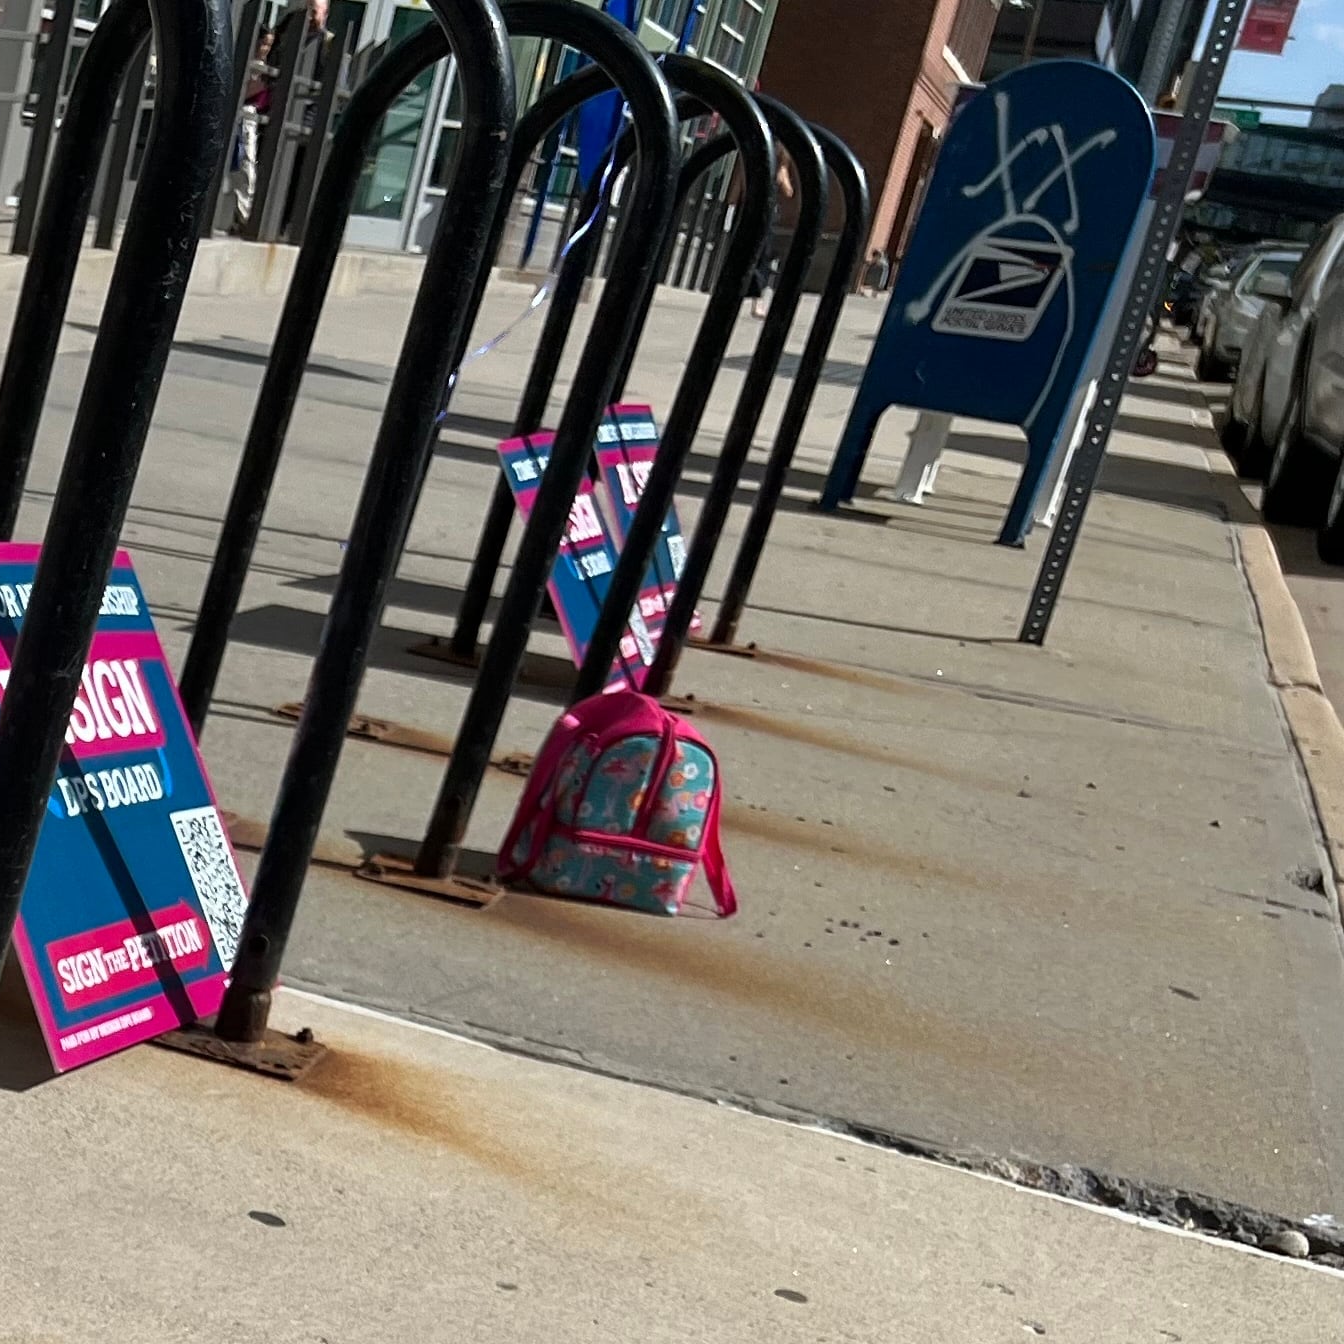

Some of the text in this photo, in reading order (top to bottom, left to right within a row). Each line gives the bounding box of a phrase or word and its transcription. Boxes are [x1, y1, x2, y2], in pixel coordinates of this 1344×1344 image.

[57, 763, 163, 816] DPS BOARD
[58, 919, 203, 994] SIGN THE PETITION
